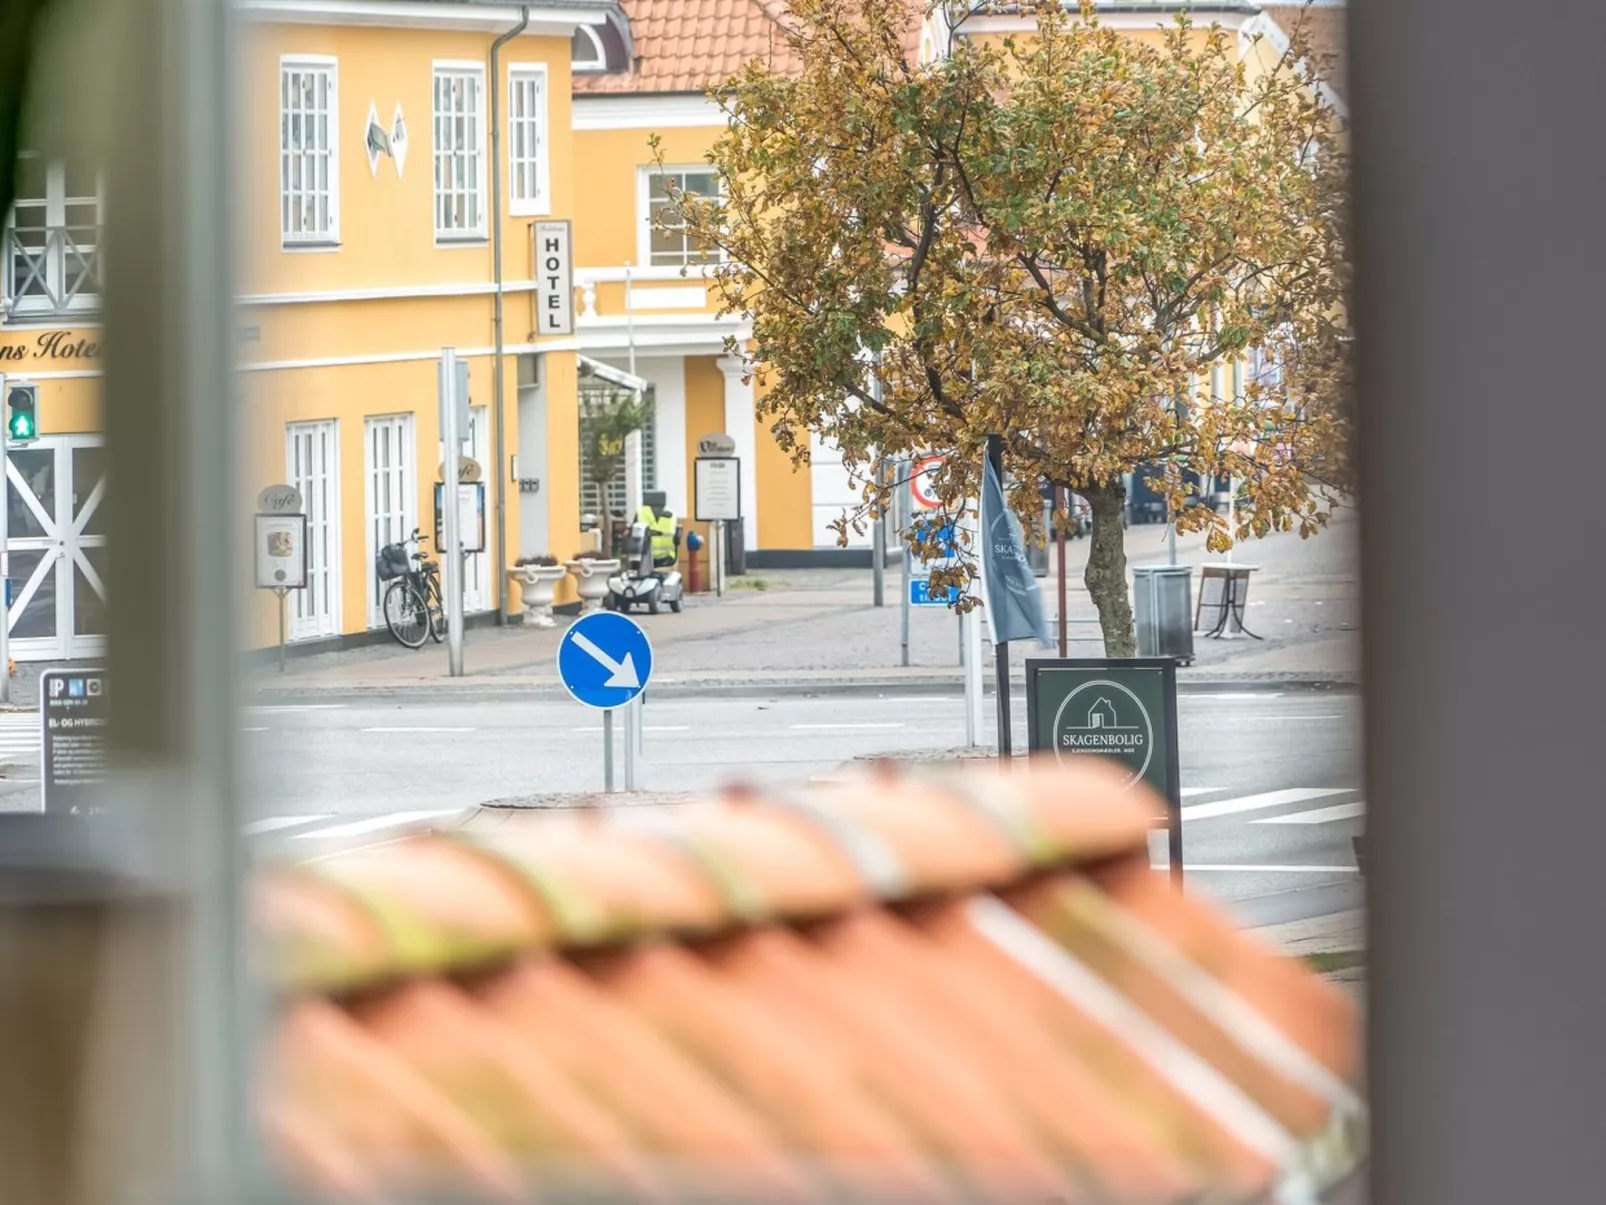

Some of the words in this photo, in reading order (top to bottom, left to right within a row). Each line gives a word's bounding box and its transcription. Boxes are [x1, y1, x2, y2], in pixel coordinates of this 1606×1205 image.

[545, 238, 561, 328] HOTEL
[33, 331, 103, 359] Hote
[61, 718, 73, 728] OG
[1062, 734, 1144, 746] SKAGENBOLIG
